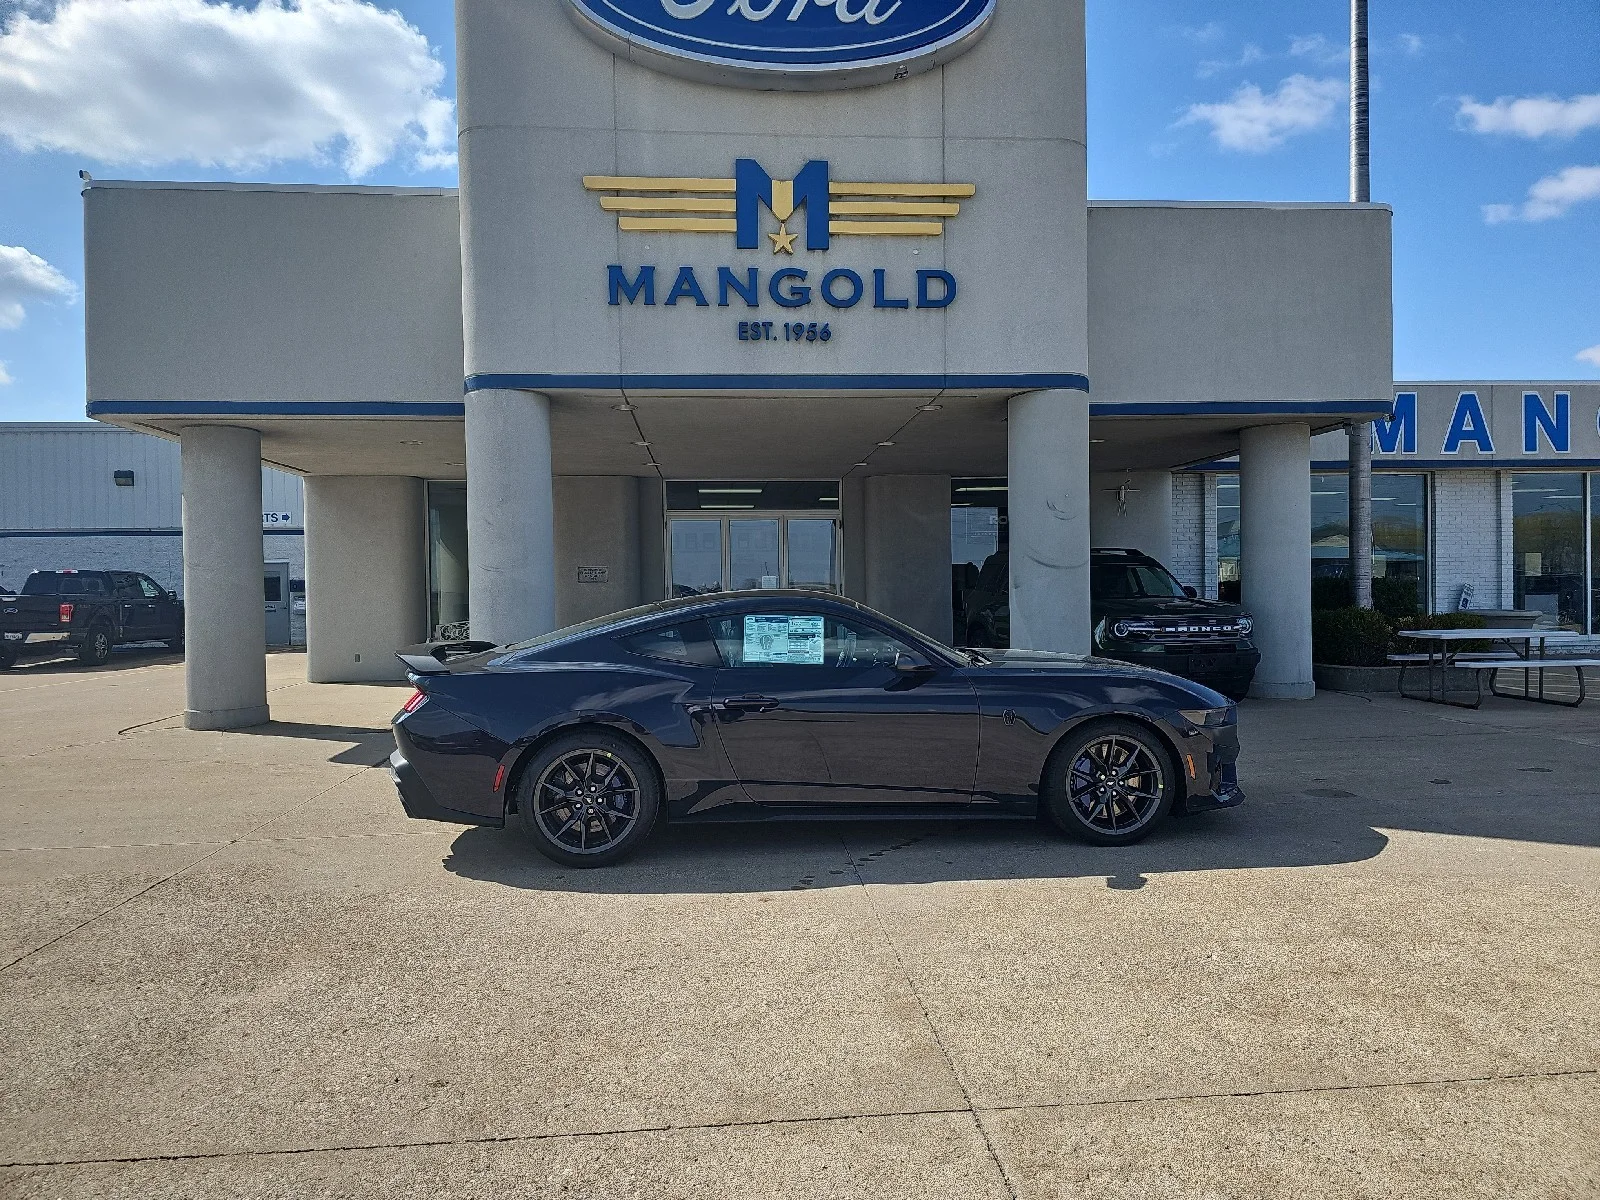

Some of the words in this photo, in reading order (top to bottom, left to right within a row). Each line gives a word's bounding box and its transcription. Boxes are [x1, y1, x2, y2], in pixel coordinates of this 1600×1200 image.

[735, 158, 830, 251] M
[606, 265, 957, 309] MANGOLD
[738, 321, 778, 341] EST.
[783, 322, 832, 342] 1956
[1371, 391, 1600, 455] MAN
[262, 512, 279, 523] TS
